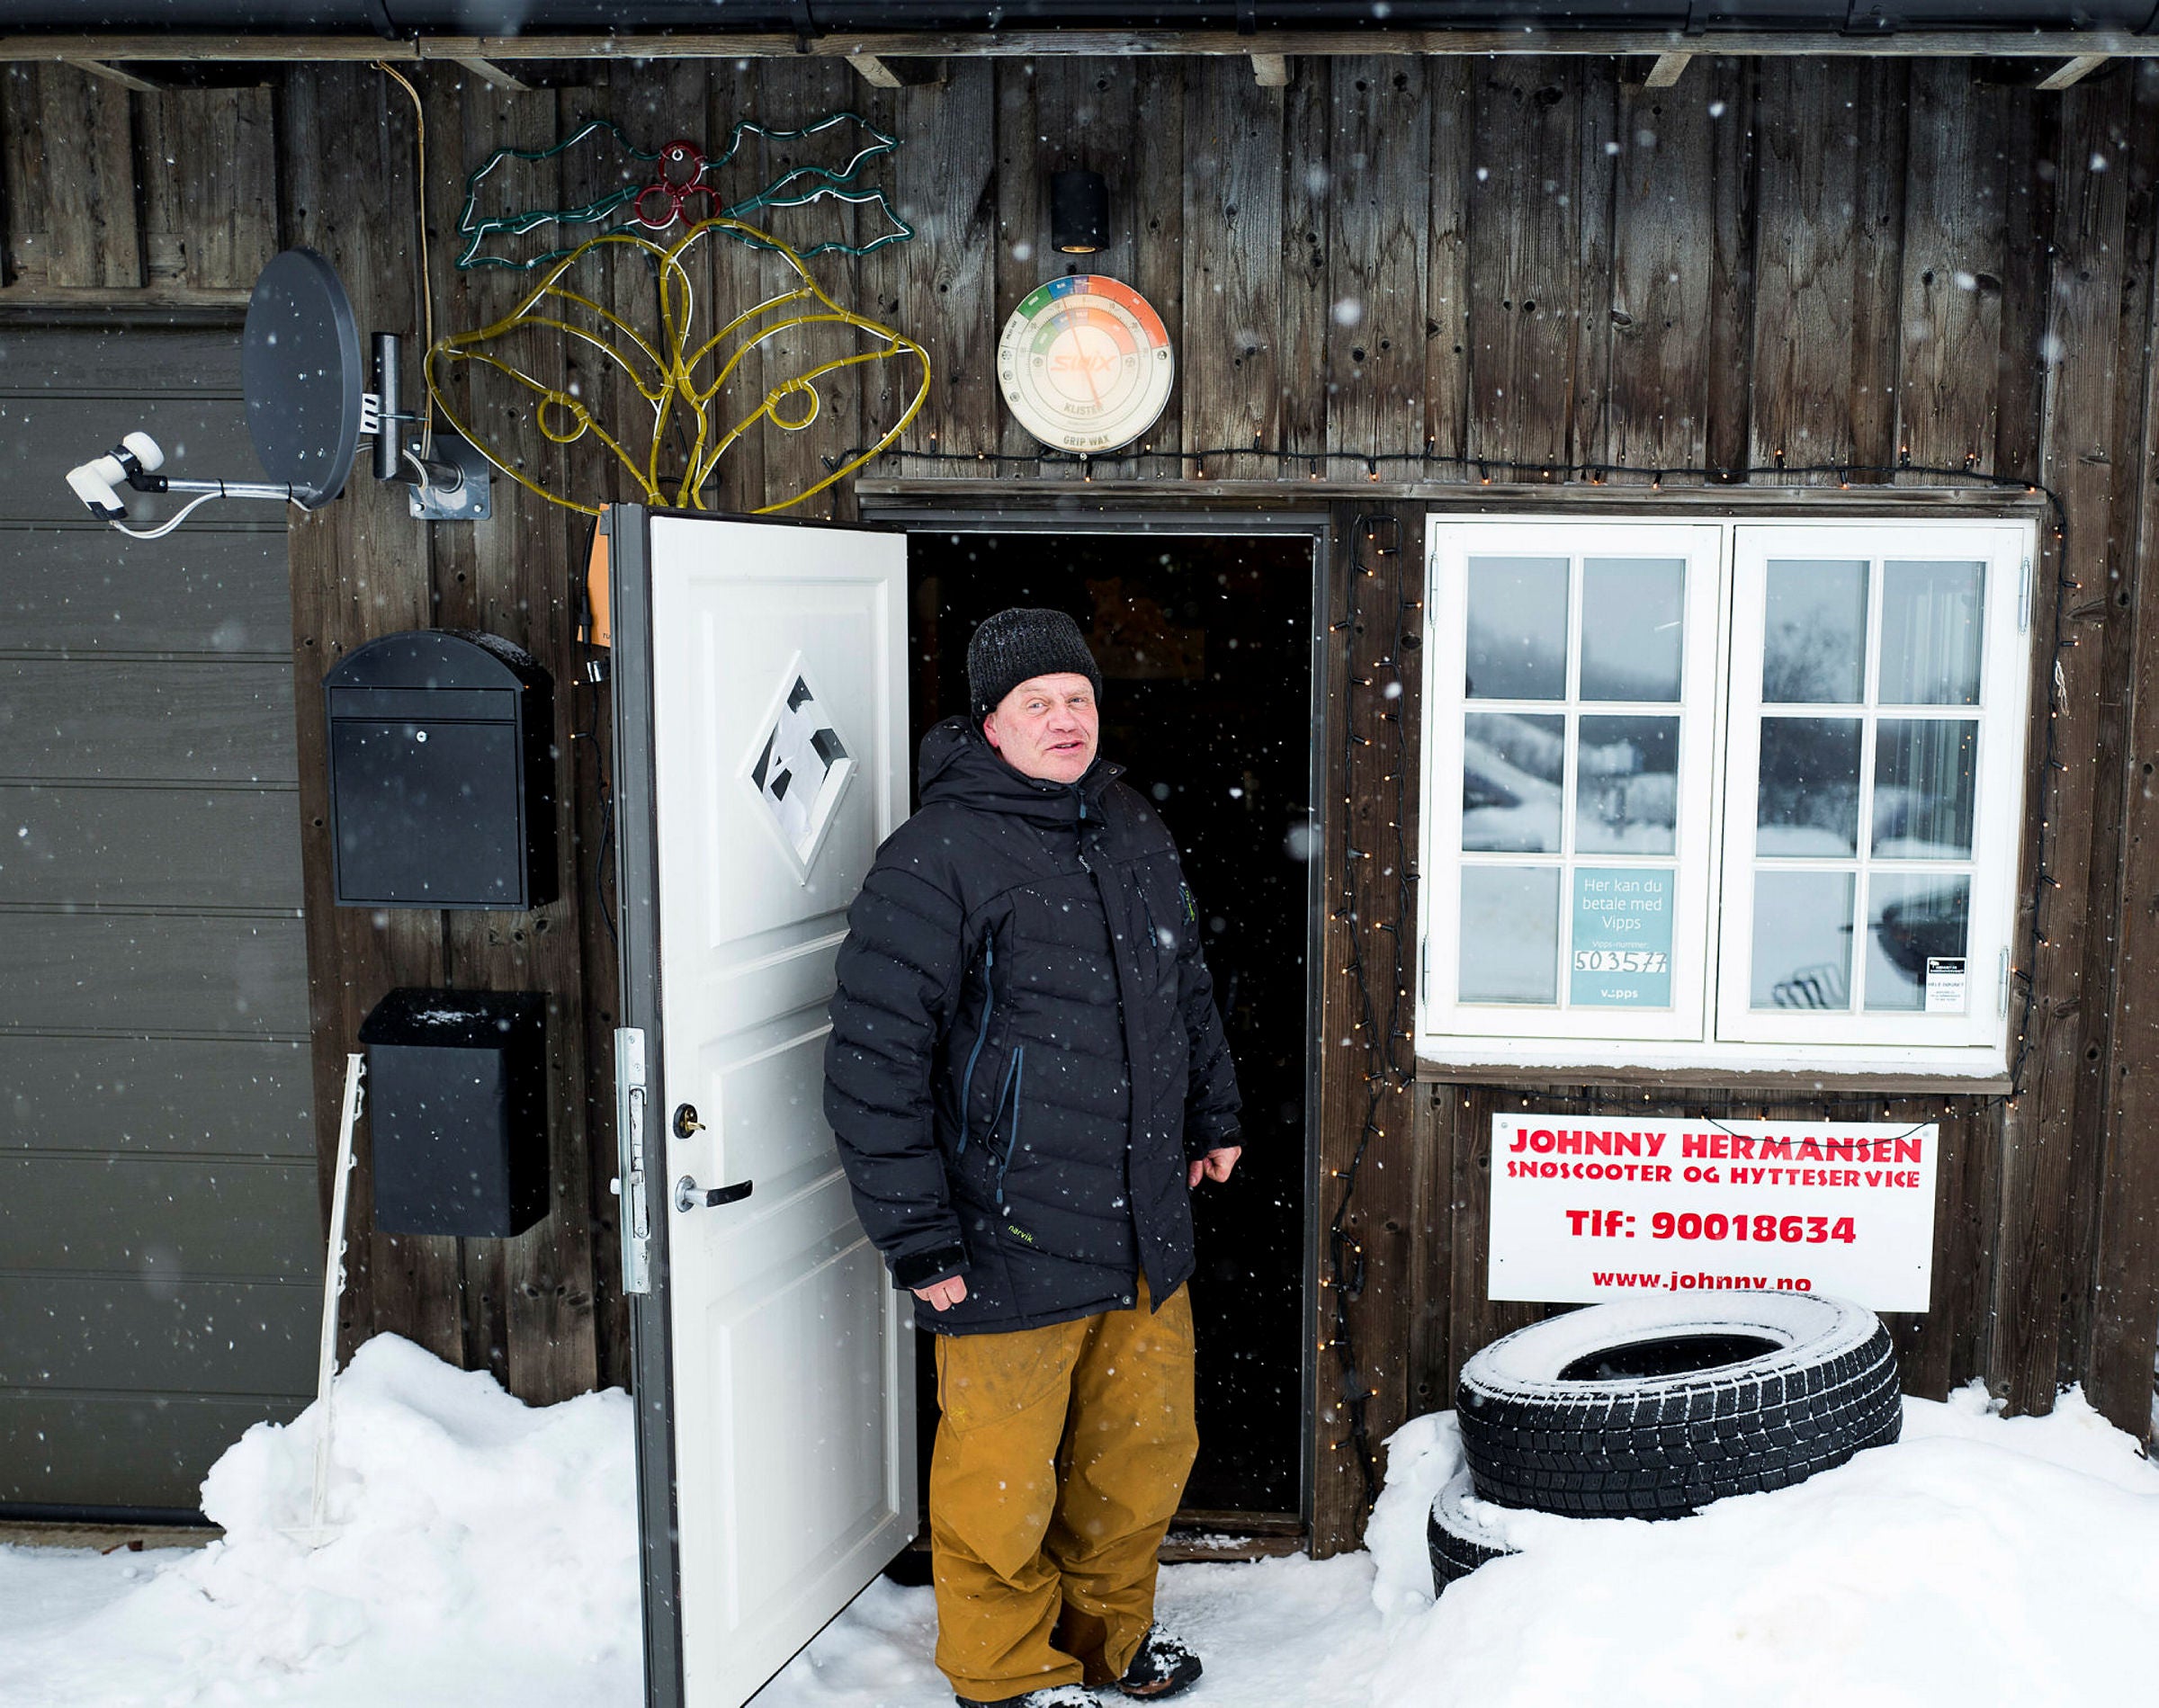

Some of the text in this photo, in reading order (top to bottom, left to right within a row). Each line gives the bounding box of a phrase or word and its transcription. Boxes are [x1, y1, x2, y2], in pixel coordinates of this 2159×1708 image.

[1063, 434, 1110, 447] GRIP WAX
[1584, 878, 1662, 893] Her kan du
[1582, 897, 1662, 911] betale med
[1602, 916, 1642, 932] Vipps
[1509, 1129, 1922, 1164] JOHNNY HERMANSEN
[1506, 1160, 1921, 1188] SNØSCOOTER OG HYTTESERVICE
[1008, 1224, 1035, 1244] narvik
[1565, 1210, 1857, 1244] Tlf: 90018634
